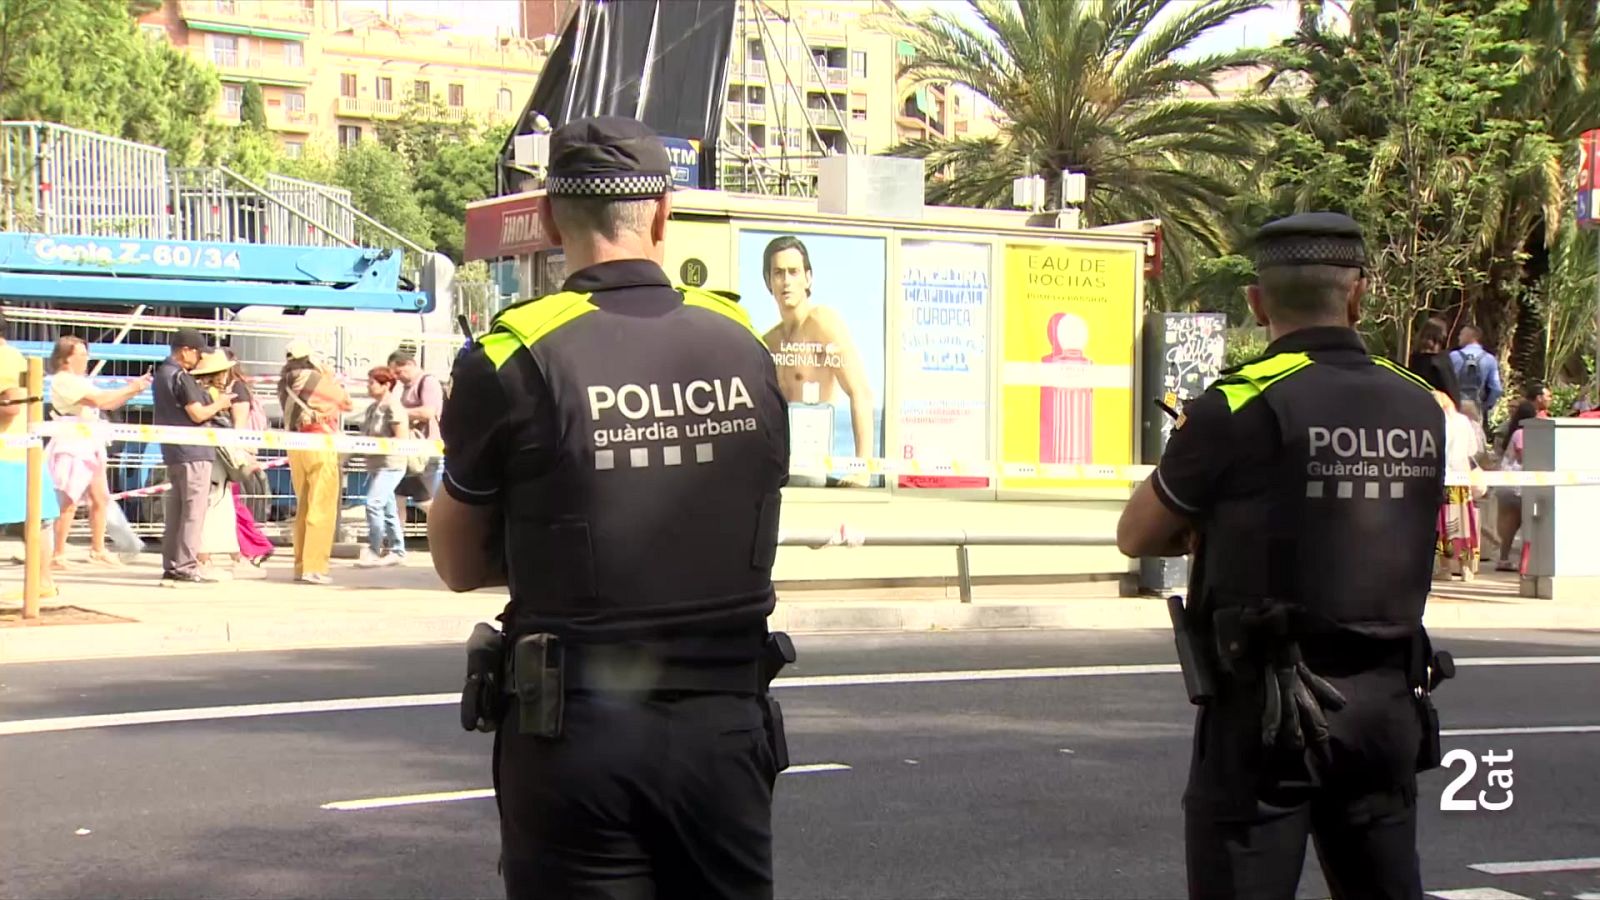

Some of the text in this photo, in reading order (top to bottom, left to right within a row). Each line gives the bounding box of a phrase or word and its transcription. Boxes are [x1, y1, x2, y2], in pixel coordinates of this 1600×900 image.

[35, 238, 241, 271] Genie Z-60/34
[1028, 255, 1106, 273] EAU DE
[1028, 272, 1106, 288] ROCHAS
[780, 342, 822, 353] LACOSTE
[587, 376, 755, 420] POLICIA
[593, 417, 757, 447] guàrdia urbana
[1308, 426, 1437, 459] POLICIA
[1306, 460, 1437, 478] Guàrdia Urbana
